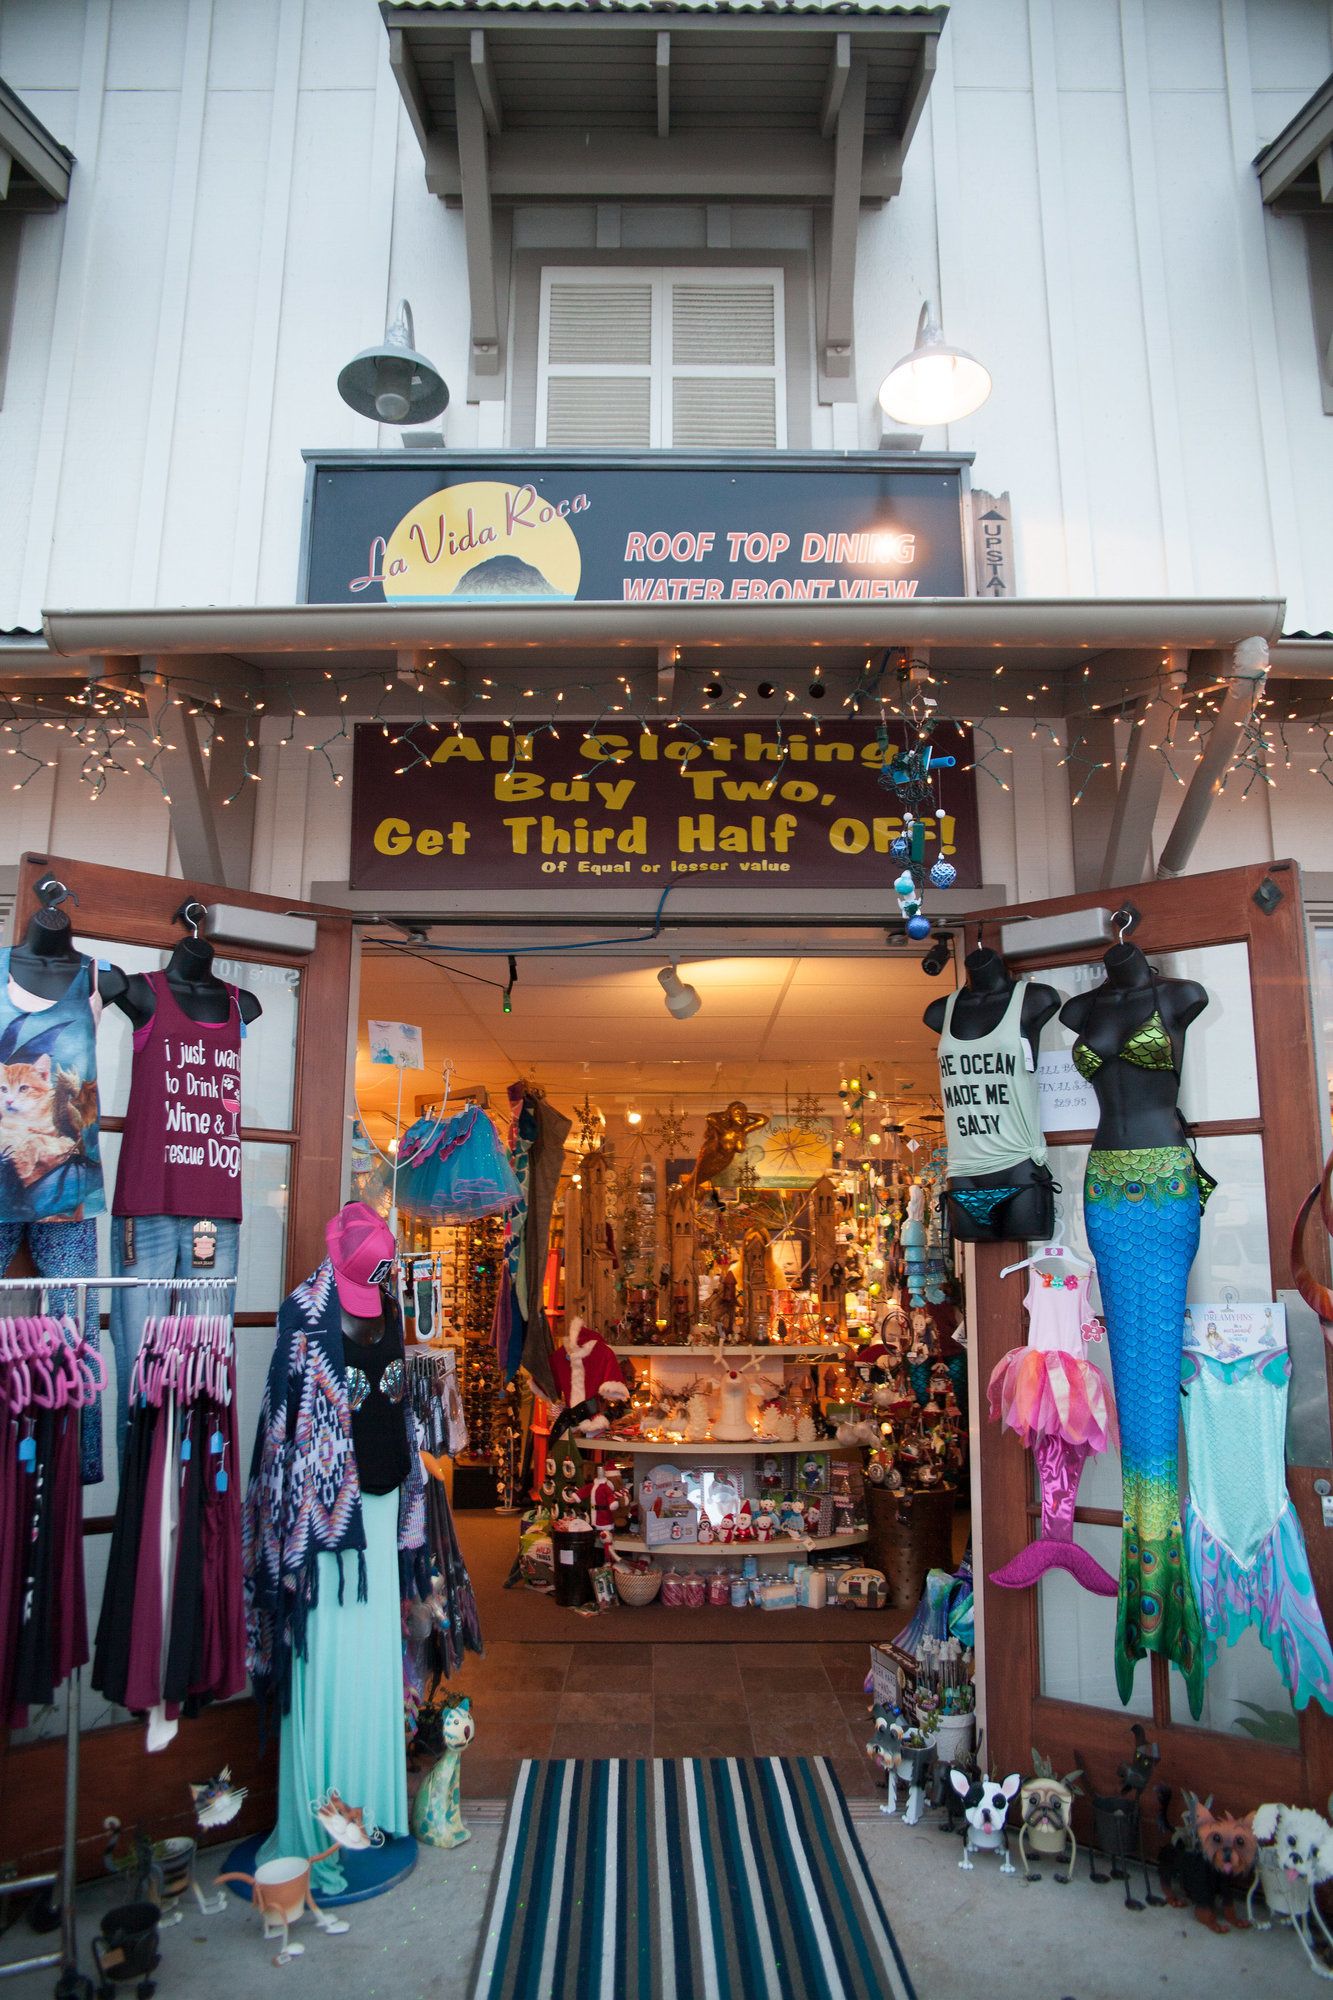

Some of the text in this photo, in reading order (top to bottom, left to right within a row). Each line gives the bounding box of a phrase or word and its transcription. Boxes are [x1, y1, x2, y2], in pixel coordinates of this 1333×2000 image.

[349, 483, 592, 593] La Vida Roca
[624, 532, 715, 563] ROOF
[726, 532, 791, 563] TOP
[622, 578, 919, 600] WATER FRONT VIEW
[430, 733, 899, 769] All Clothing
[494, 770, 836, 810] Buy Two,
[373, 817, 472, 856] Get
[503, 815, 648, 855] Third
[678, 813, 798, 853] Half
[541, 860, 791, 876] Of Equal or lesser value
[164, 1039, 241, 1071] i just wan
[938, 1053, 1016, 1078] HE OCEAN
[165, 1070, 219, 1099] to Drink
[943, 1084, 1010, 1108] MADE ME
[165, 1100, 225, 1135] Wine &
[957, 1114, 1001, 1137] SALTY
[164, 1138, 241, 1178] rescue Dog
